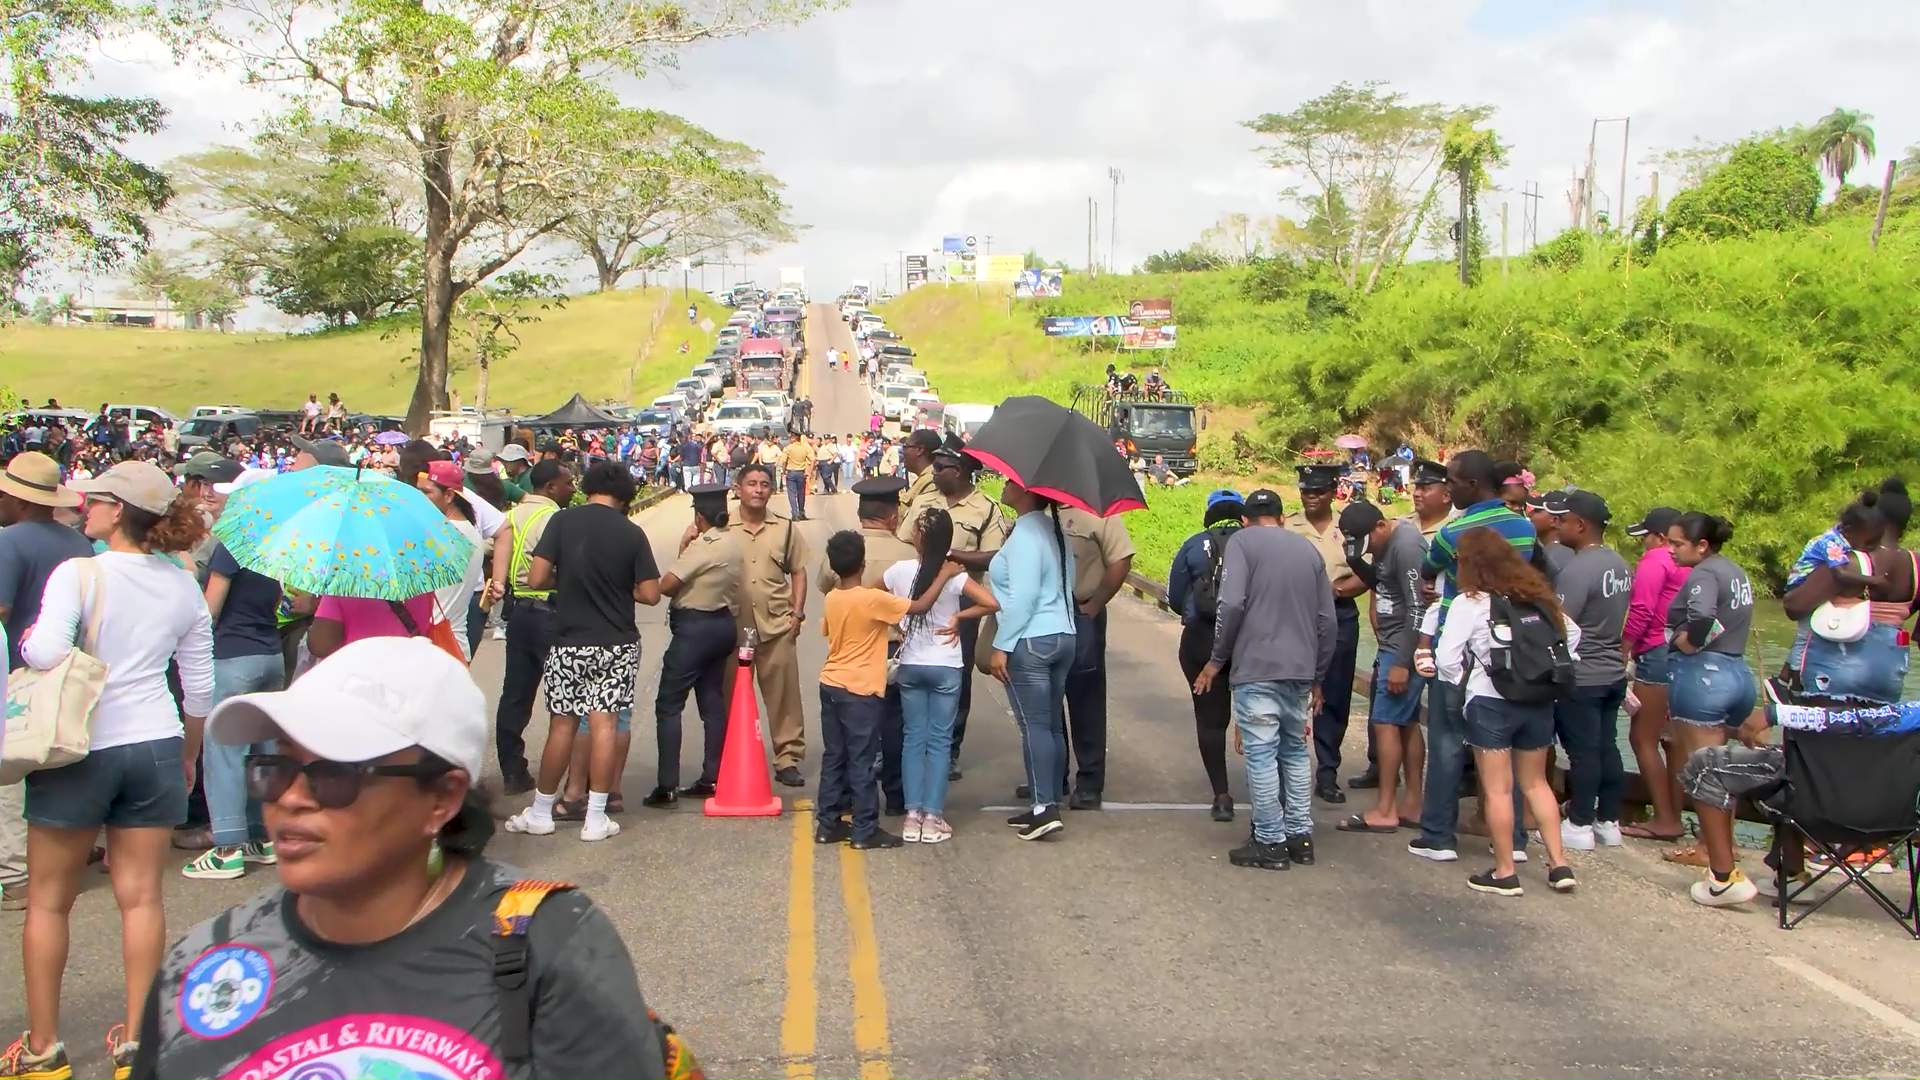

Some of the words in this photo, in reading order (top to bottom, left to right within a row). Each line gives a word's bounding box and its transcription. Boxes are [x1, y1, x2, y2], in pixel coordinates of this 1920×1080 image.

[1602, 568, 1632, 598] Chris
[337, 1022, 360, 1046] &
[365, 1021, 493, 1080] RIVERWAYS
